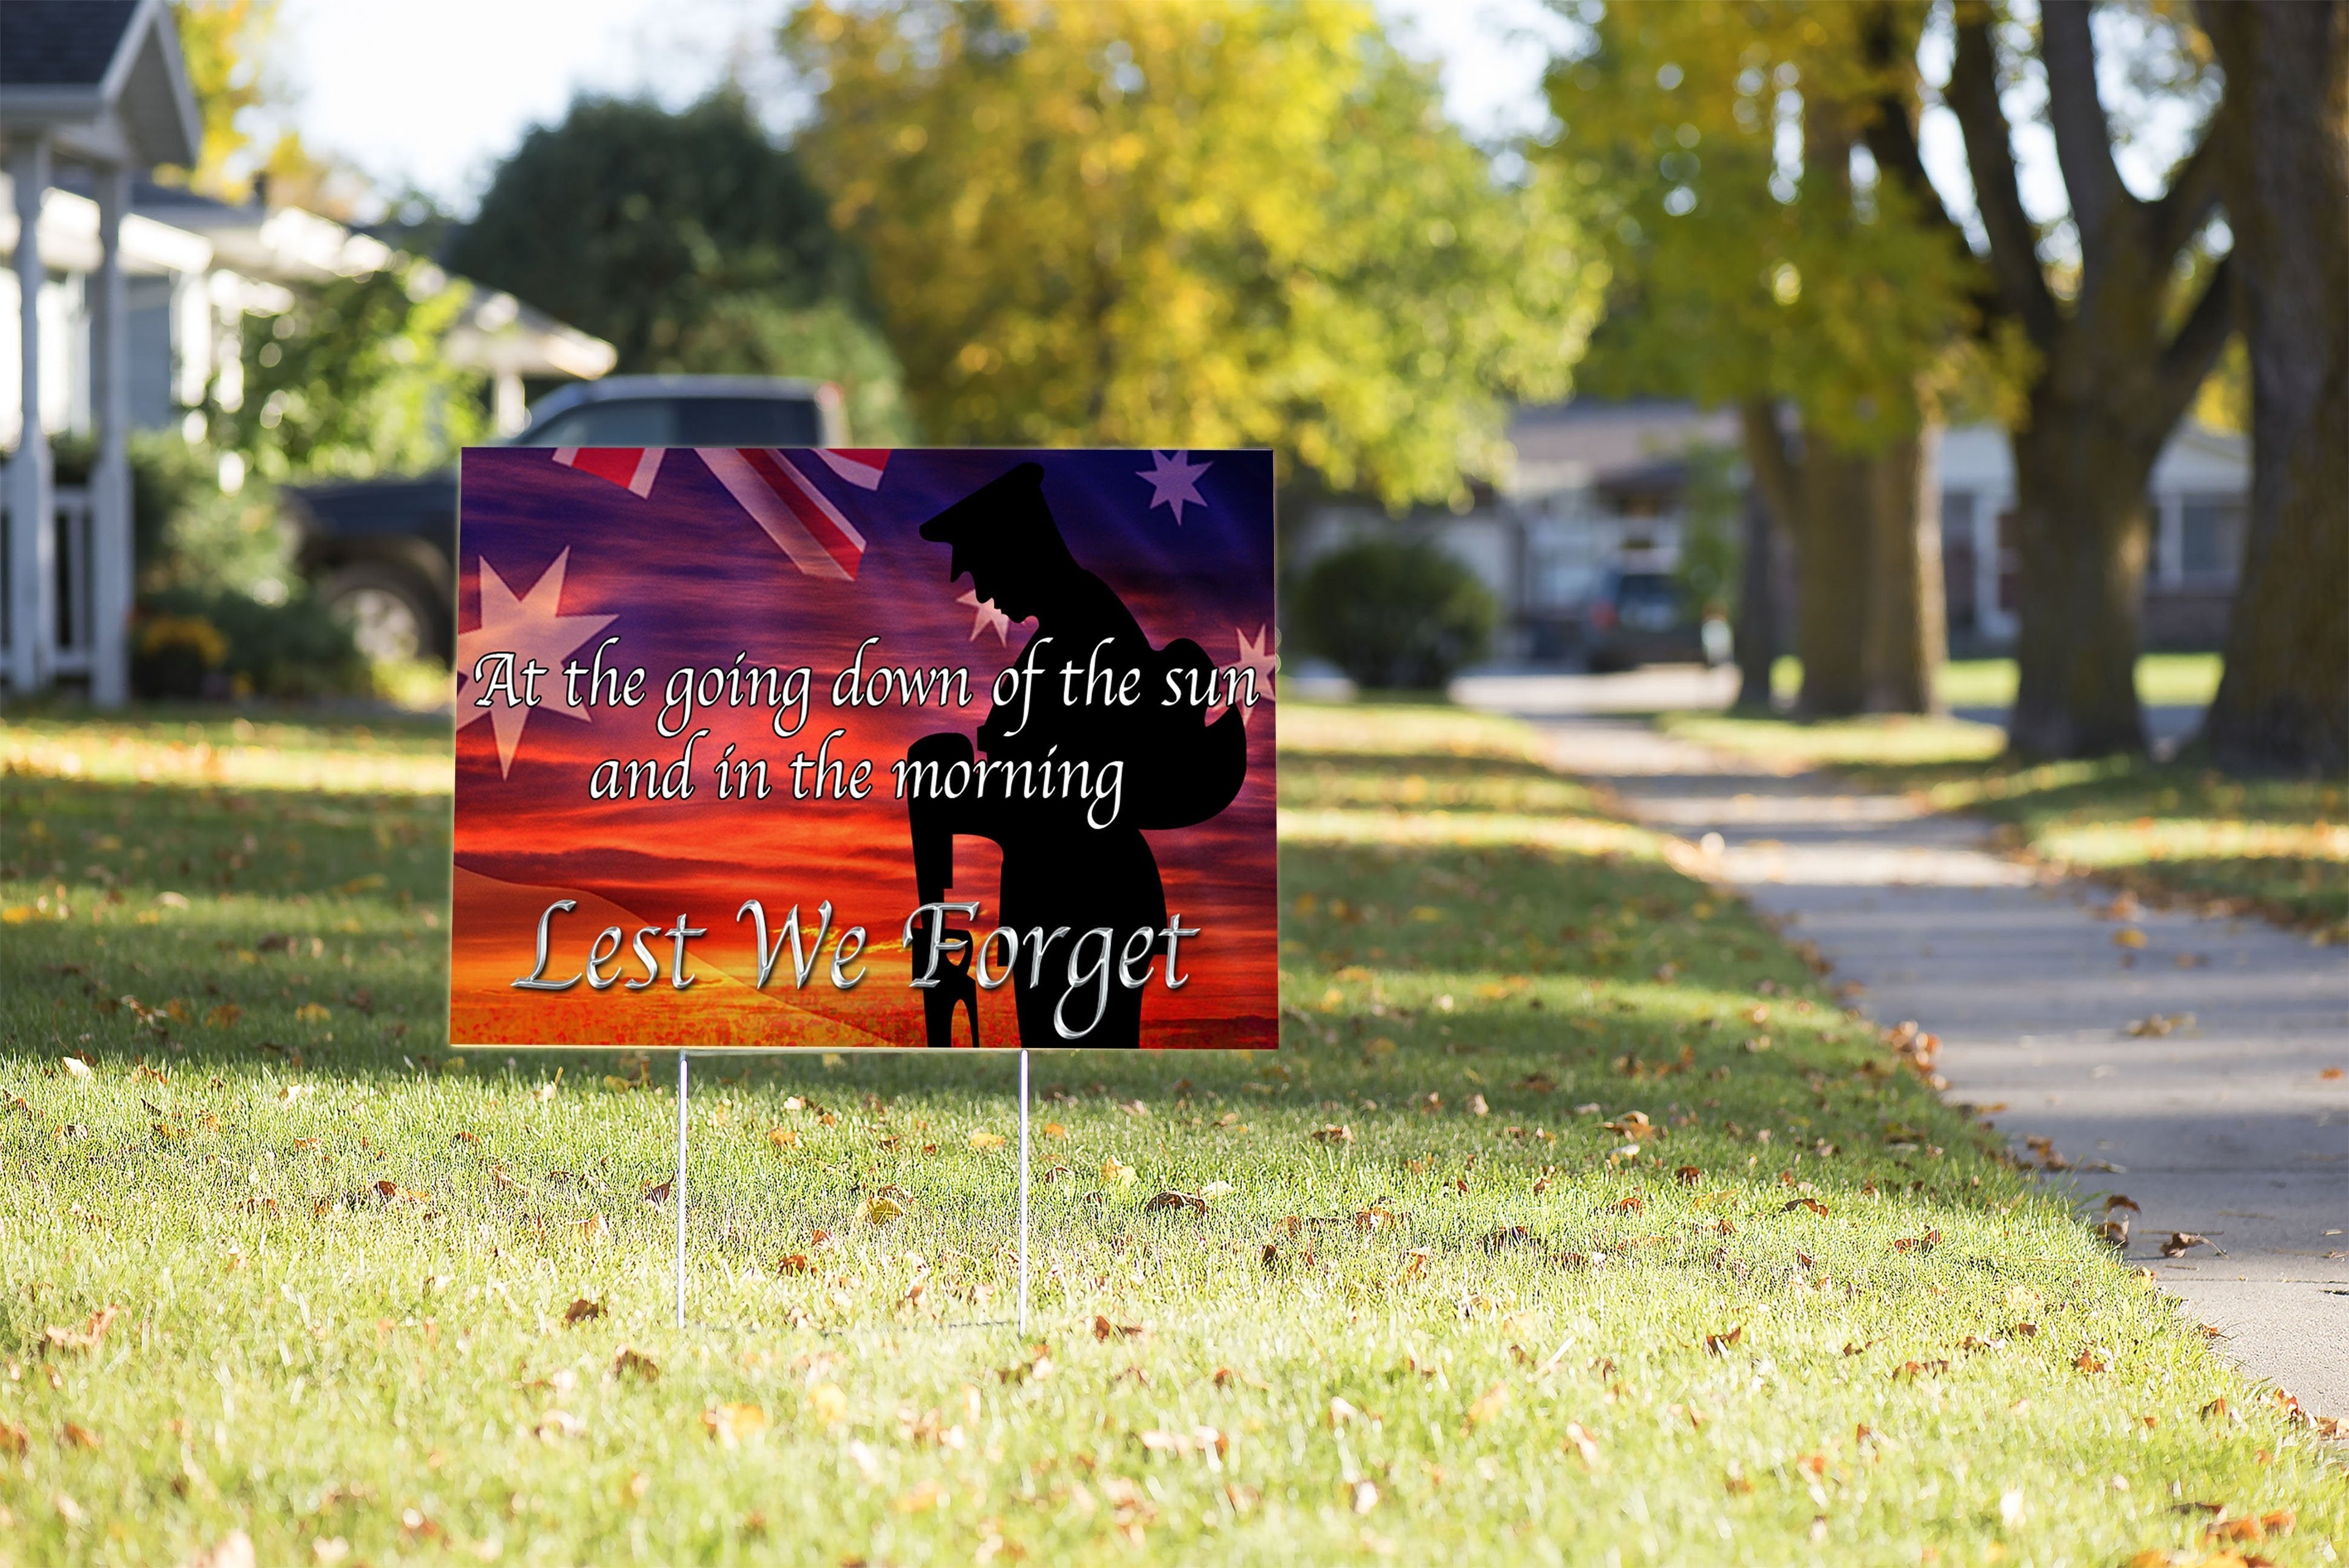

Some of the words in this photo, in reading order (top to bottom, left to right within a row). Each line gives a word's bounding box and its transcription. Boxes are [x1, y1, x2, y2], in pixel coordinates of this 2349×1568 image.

[474, 652, 548, 708] At
[563, 637, 646, 707] the
[656, 651, 812, 738] going
[831, 636, 973, 708] down
[992, 637, 1054, 737] of
[1059, 637, 1141, 706] the
[1161, 666, 1260, 708] sun
[588, 728, 710, 800] and
[714, 744, 771, 800] in
[790, 728, 873, 800] the
[891, 743, 1124, 830] morning
[510, 899, 708, 990] Lest
[736, 899, 866, 990] We
[902, 901, 1201, 1040] Forget
